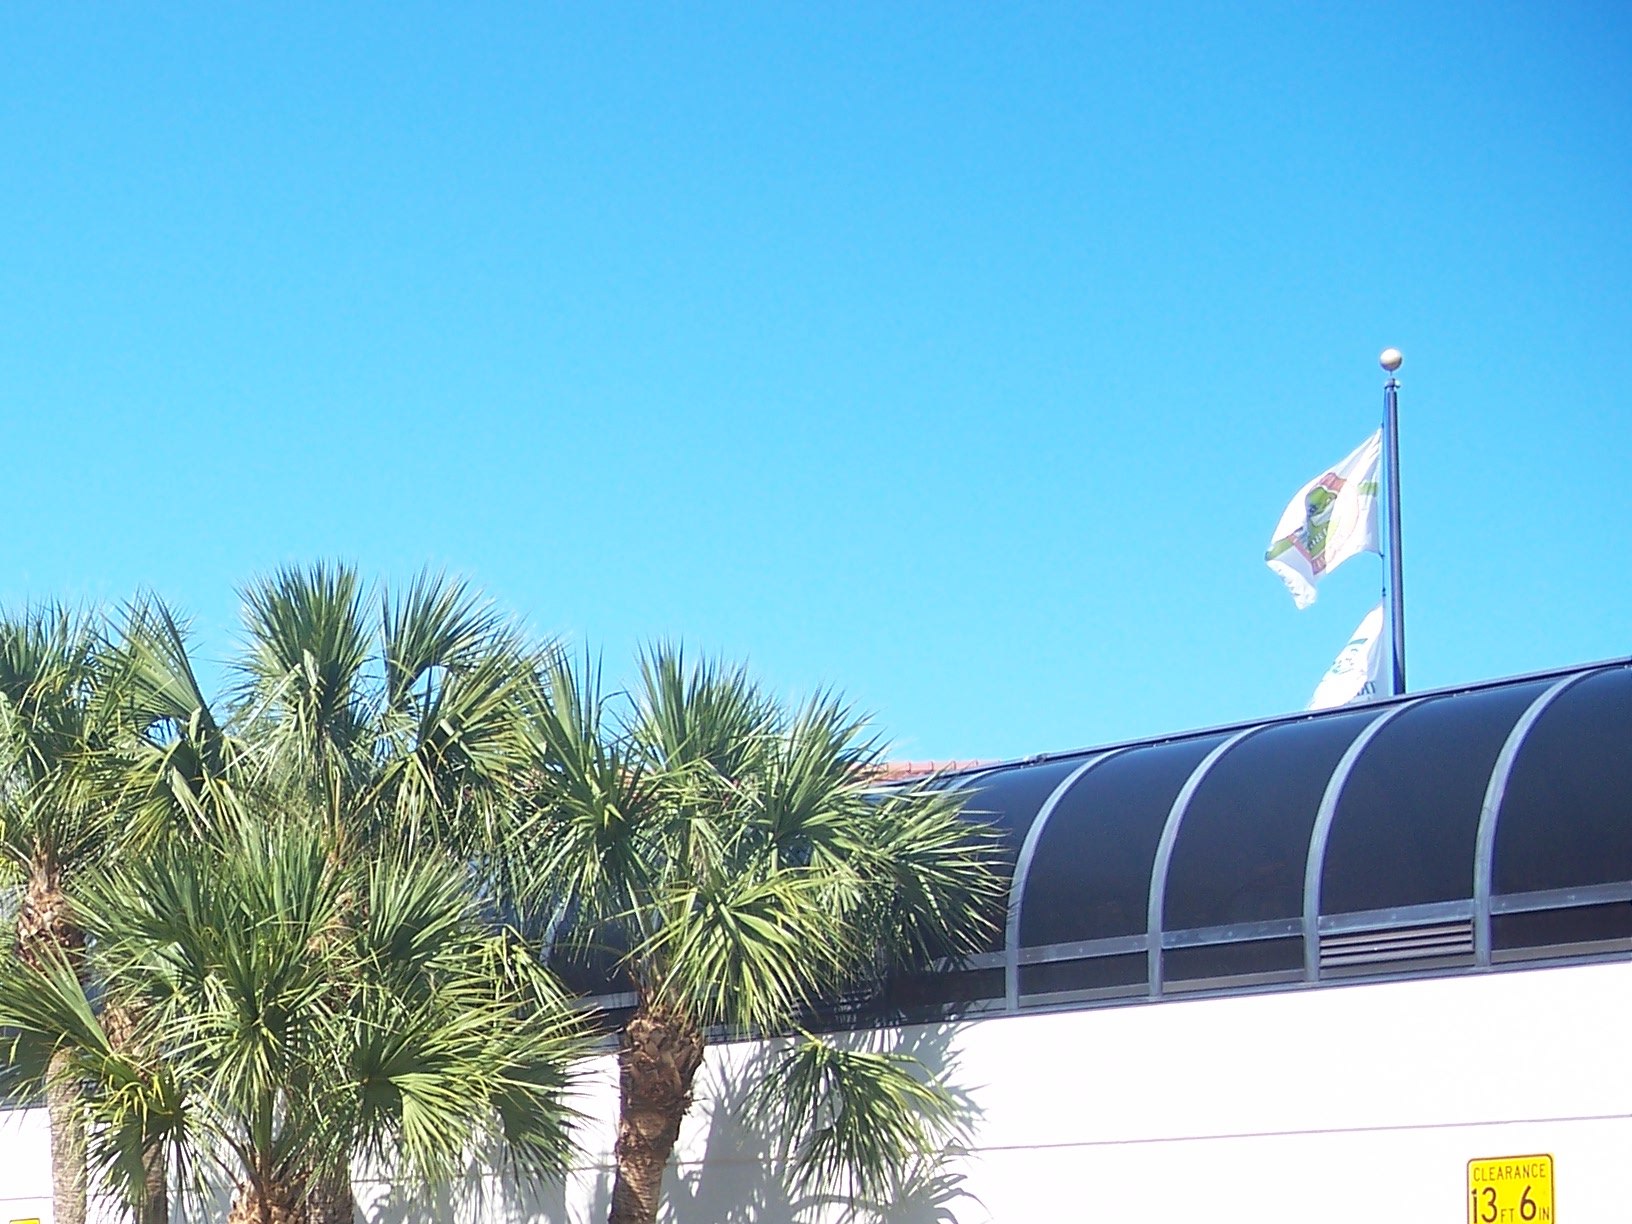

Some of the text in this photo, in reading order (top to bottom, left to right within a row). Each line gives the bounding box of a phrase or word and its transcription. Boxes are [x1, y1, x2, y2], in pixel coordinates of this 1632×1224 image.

[1473, 1163, 1546, 1182] CLEARANCE
[1471, 1184, 1550, 1224] 13 FT 6 IN
